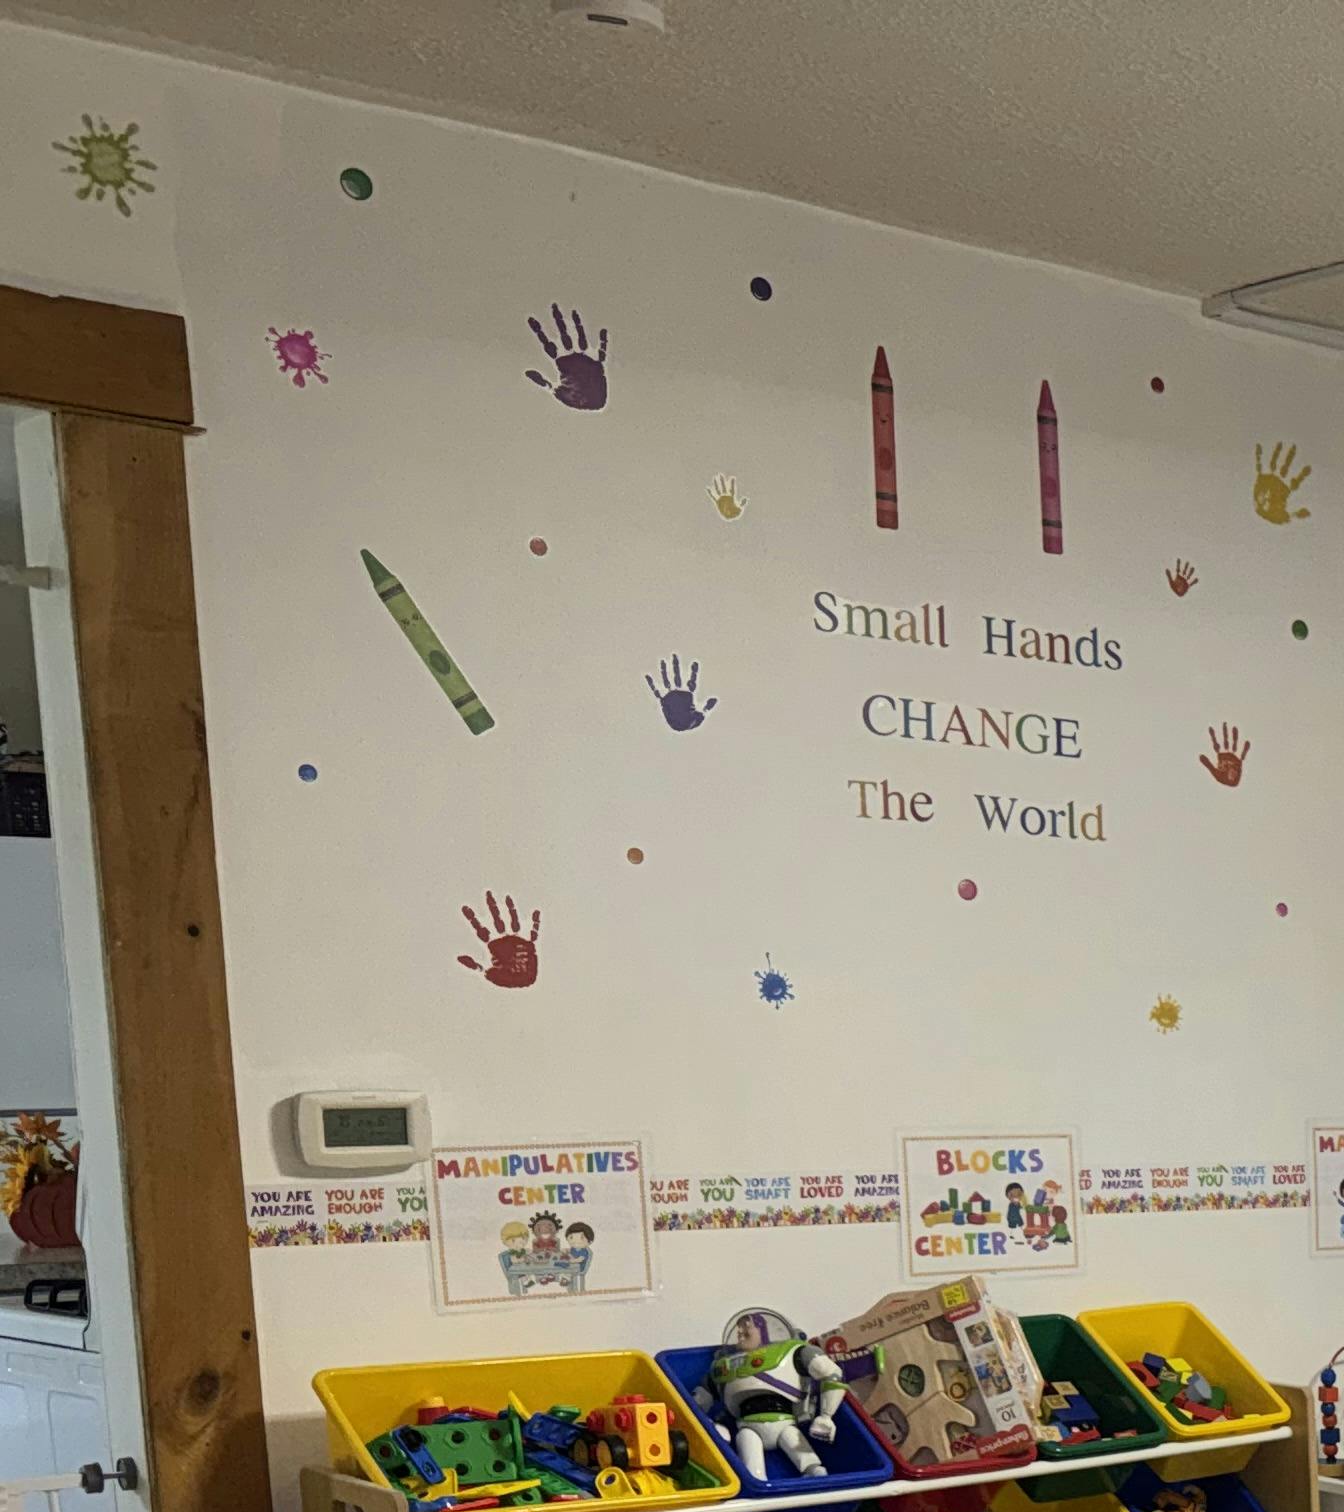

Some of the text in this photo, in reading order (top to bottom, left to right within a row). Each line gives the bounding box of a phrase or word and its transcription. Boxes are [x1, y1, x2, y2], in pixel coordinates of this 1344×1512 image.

[813, 591, 1123, 671] Small Hands
[862, 694, 1083, 758] CHANGE
[847, 779, 1107, 841] The World
[437, 1152, 639, 1179] MANIPULATIVES
[936, 1148, 1044, 1176] BLOCKS
[1102, 1168, 1121, 1178] YOU
[1150, 1167, 1189, 1177] YOU ARE
[1273, 1165, 1288, 1173] YOU
[668, 1179, 689, 1190] ARE
[744, 1178, 767, 1187] YOU
[800, 1175, 844, 1186] YOU ARE
[854, 1174, 877, 1185] YOU
[1101, 1180, 1143, 1189] AMAZING
[1197, 1174, 1223, 1187] YOU
[1272, 1174, 1306, 1185] LOVED
[251, 1190, 312, 1203] YOU ARE
[325, 1187, 384, 1201] YOU ARE
[396, 1187, 415, 1196] YOU
[498, 1183, 585, 1206] CENTER
[700, 1188, 735, 1202] YOU
[744, 1187, 791, 1200] SMART
[800, 1186, 844, 1198] LOVED
[251, 1204, 315, 1217] AMAZING
[328, 1202, 382, 1215] ENOUGH
[915, 1231, 1007, 1257] CENTER
[1002, 1410, 1016, 1422] 10
